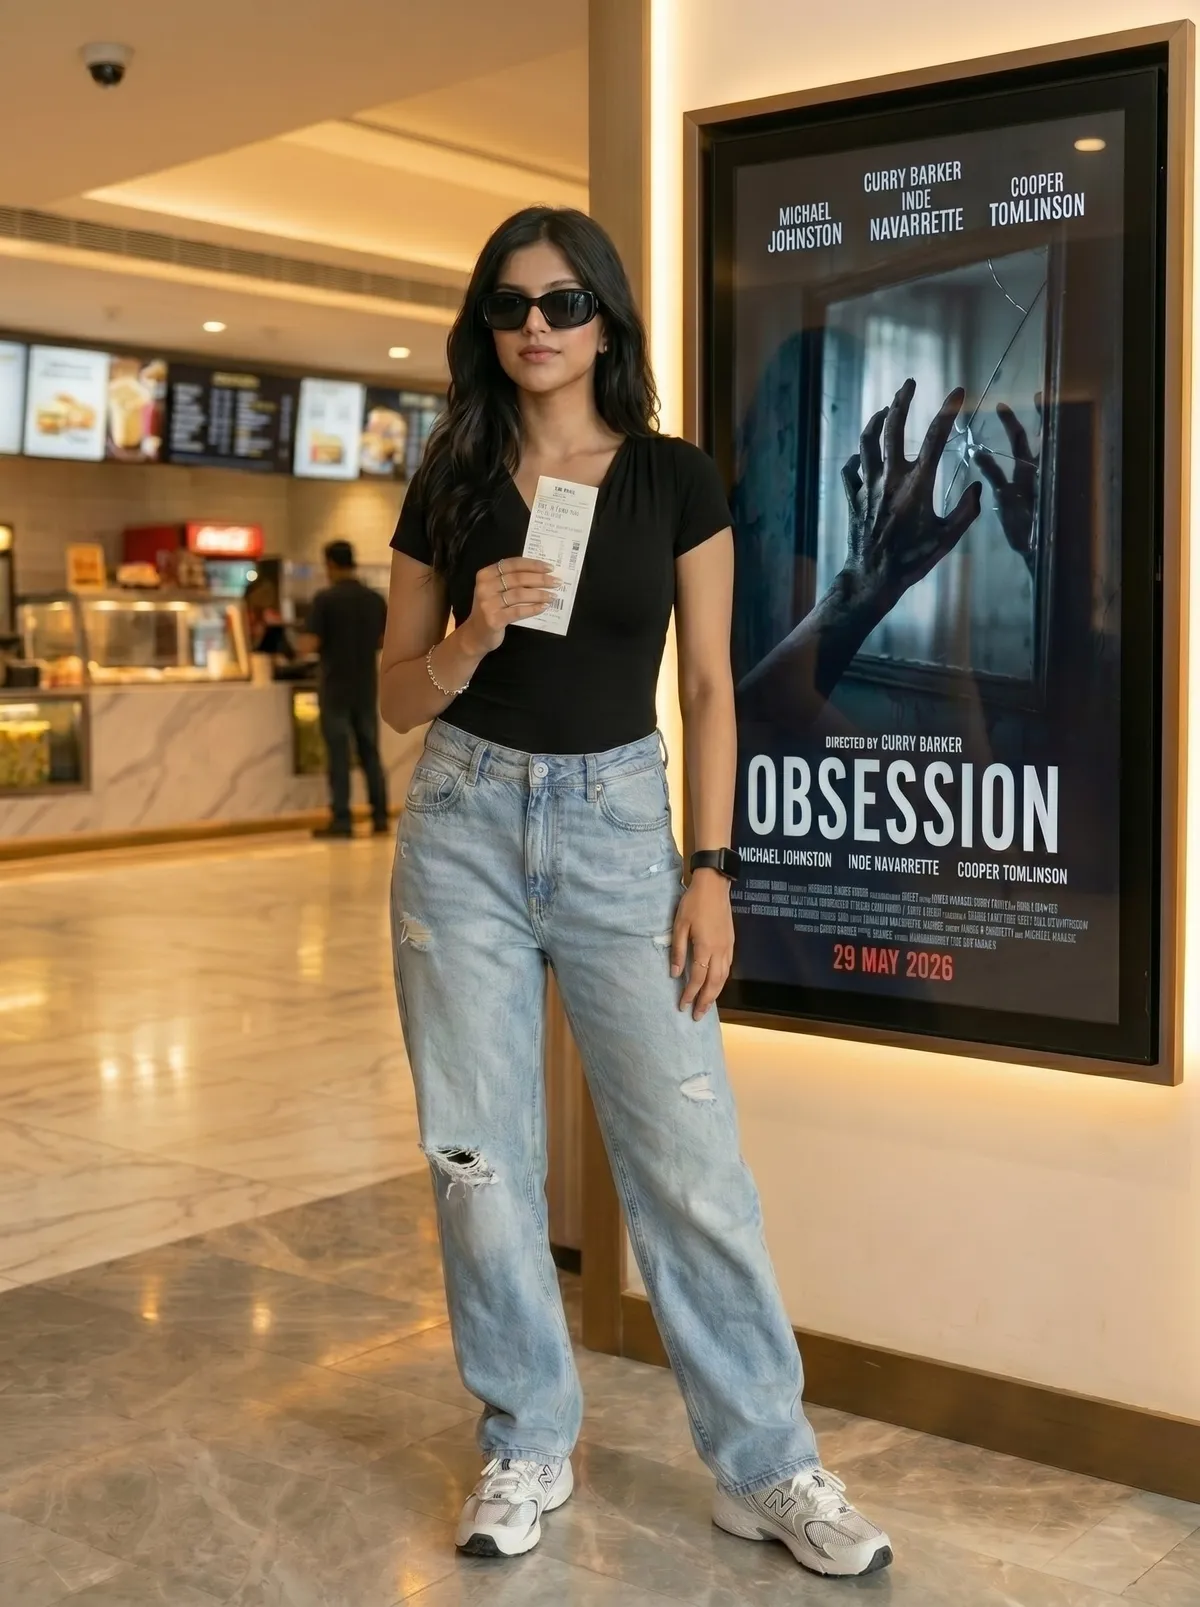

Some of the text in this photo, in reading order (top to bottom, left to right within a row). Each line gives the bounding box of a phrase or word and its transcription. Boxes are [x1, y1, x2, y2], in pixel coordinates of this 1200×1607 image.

[864, 161, 962, 192] CURRY BARKER
[1010, 172, 1064, 197] COOPER
[902, 189, 931, 211] INDE
[989, 193, 1085, 227] TOMLINSON
[779, 202, 832, 227] MICHAEL
[870, 208, 964, 242] NAVARRETTE
[768, 222, 842, 254] JOHNSTON
[825, 734, 962, 752] DIRECTED BY CURRY BARKER
[748, 754, 1059, 854] OBSESSION
[738, 847, 832, 868] MICHAEL JOHNSTON
[874, 855, 940, 876] NAVARRETTE
[957, 861, 1068, 885] COOPER TOMLINSON
[833, 943, 954, 981] 29 MAY 2026
[763, 1488, 797, 1518] N
